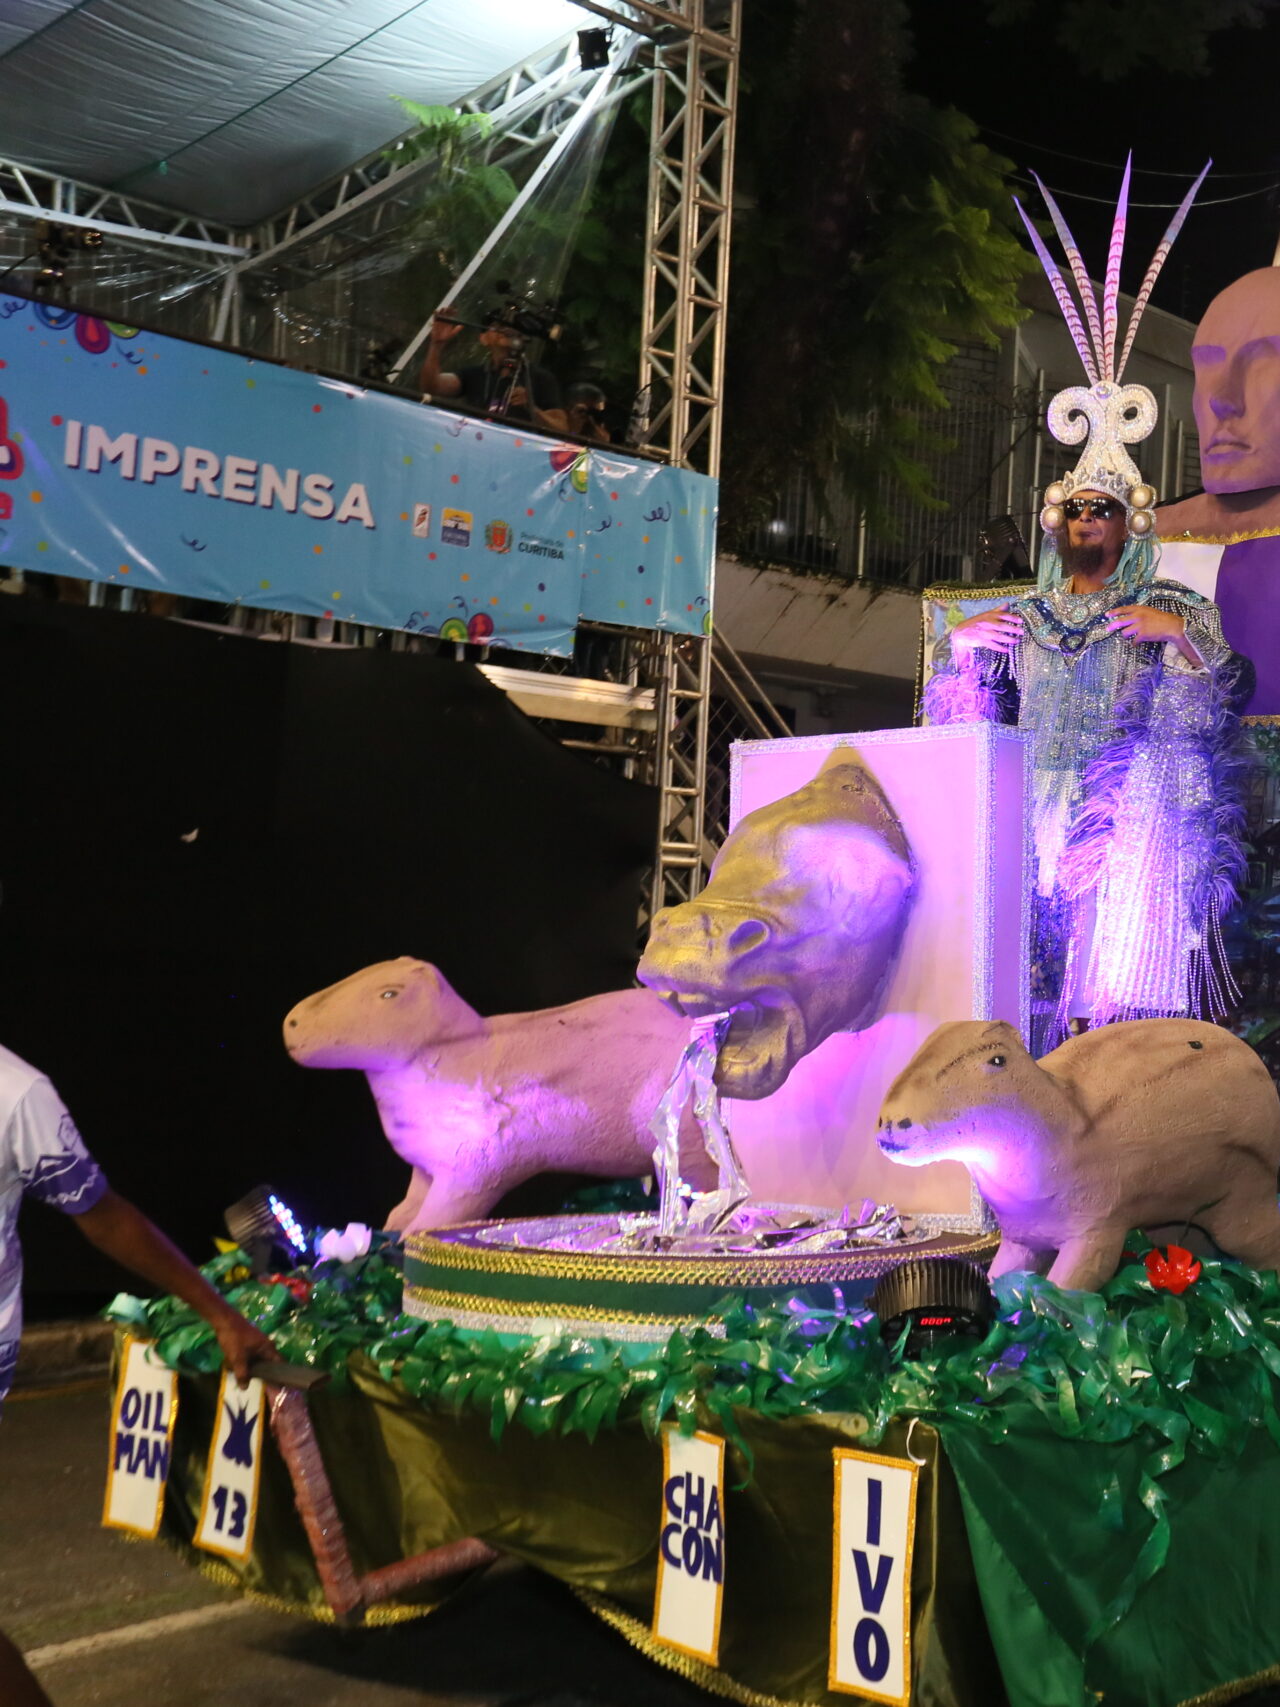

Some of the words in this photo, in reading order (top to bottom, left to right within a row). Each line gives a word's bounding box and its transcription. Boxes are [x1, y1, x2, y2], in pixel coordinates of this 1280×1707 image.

[64, 420, 375, 529] IMPRENSA
[518, 542, 564, 560] CURITIBA
[121, 1387, 169, 1434] OIL
[114, 1432, 170, 1482] MAN
[213, 1485, 248, 1539] 13
[665, 1471, 724, 1540] CHA
[661, 1522, 723, 1586] CON
[851, 1477, 894, 1682] IVO
